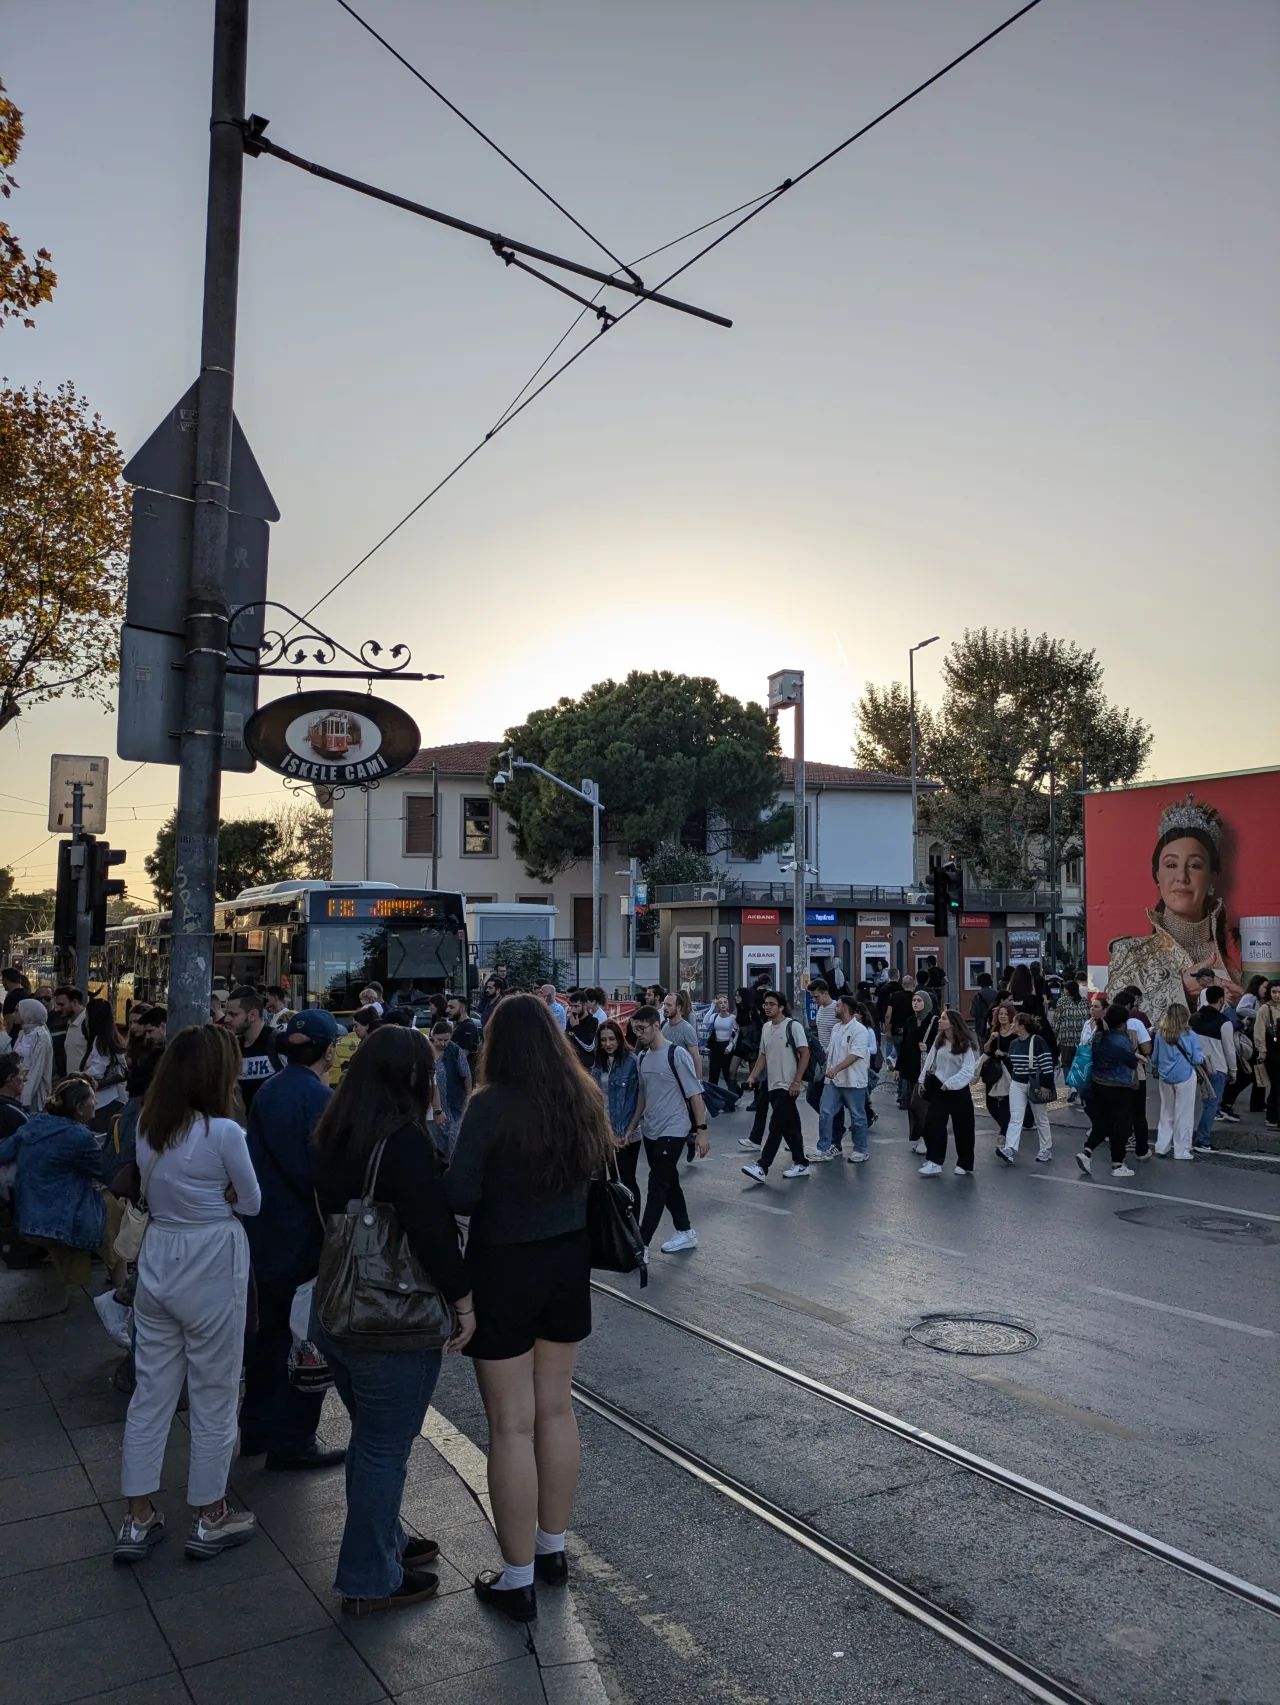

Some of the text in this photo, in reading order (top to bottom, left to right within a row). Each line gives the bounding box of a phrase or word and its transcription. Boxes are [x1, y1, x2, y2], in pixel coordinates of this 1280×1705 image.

[279, 752, 389, 781] İSKELE CAMİ
[1249, 948, 1272, 959] stella
[247, 1060, 270, 1076] BJK
